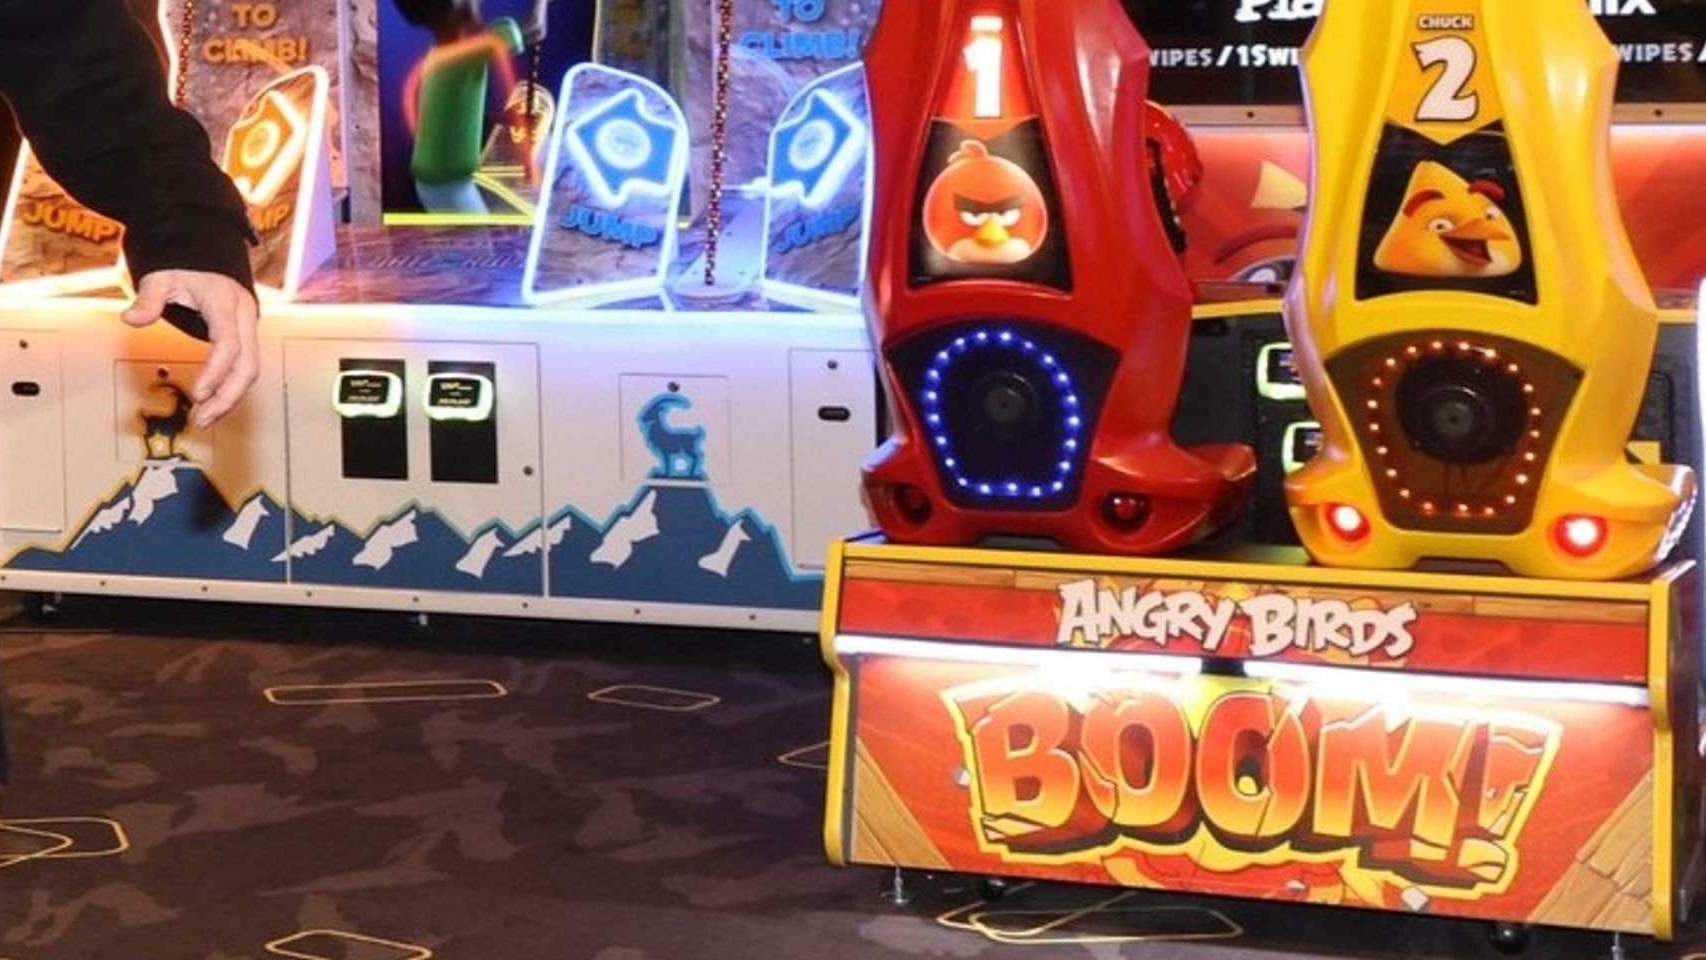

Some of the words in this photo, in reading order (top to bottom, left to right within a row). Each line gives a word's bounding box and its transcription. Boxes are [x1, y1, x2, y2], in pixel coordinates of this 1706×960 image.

[232, 3, 278, 29] TO
[1417, 14, 1475, 30] CHUCK
[963, 35, 1003, 118] 1
[1410, 34, 1480, 122] 2
[22, 202, 120, 241] JUMP
[561, 204, 662, 248] JUMP
[770, 205, 859, 254] JUMP
[1056, 579, 1236, 653] ANGRY
[1239, 592, 1417, 658] BIRDS
[962, 682, 1552, 888] BOOM!
